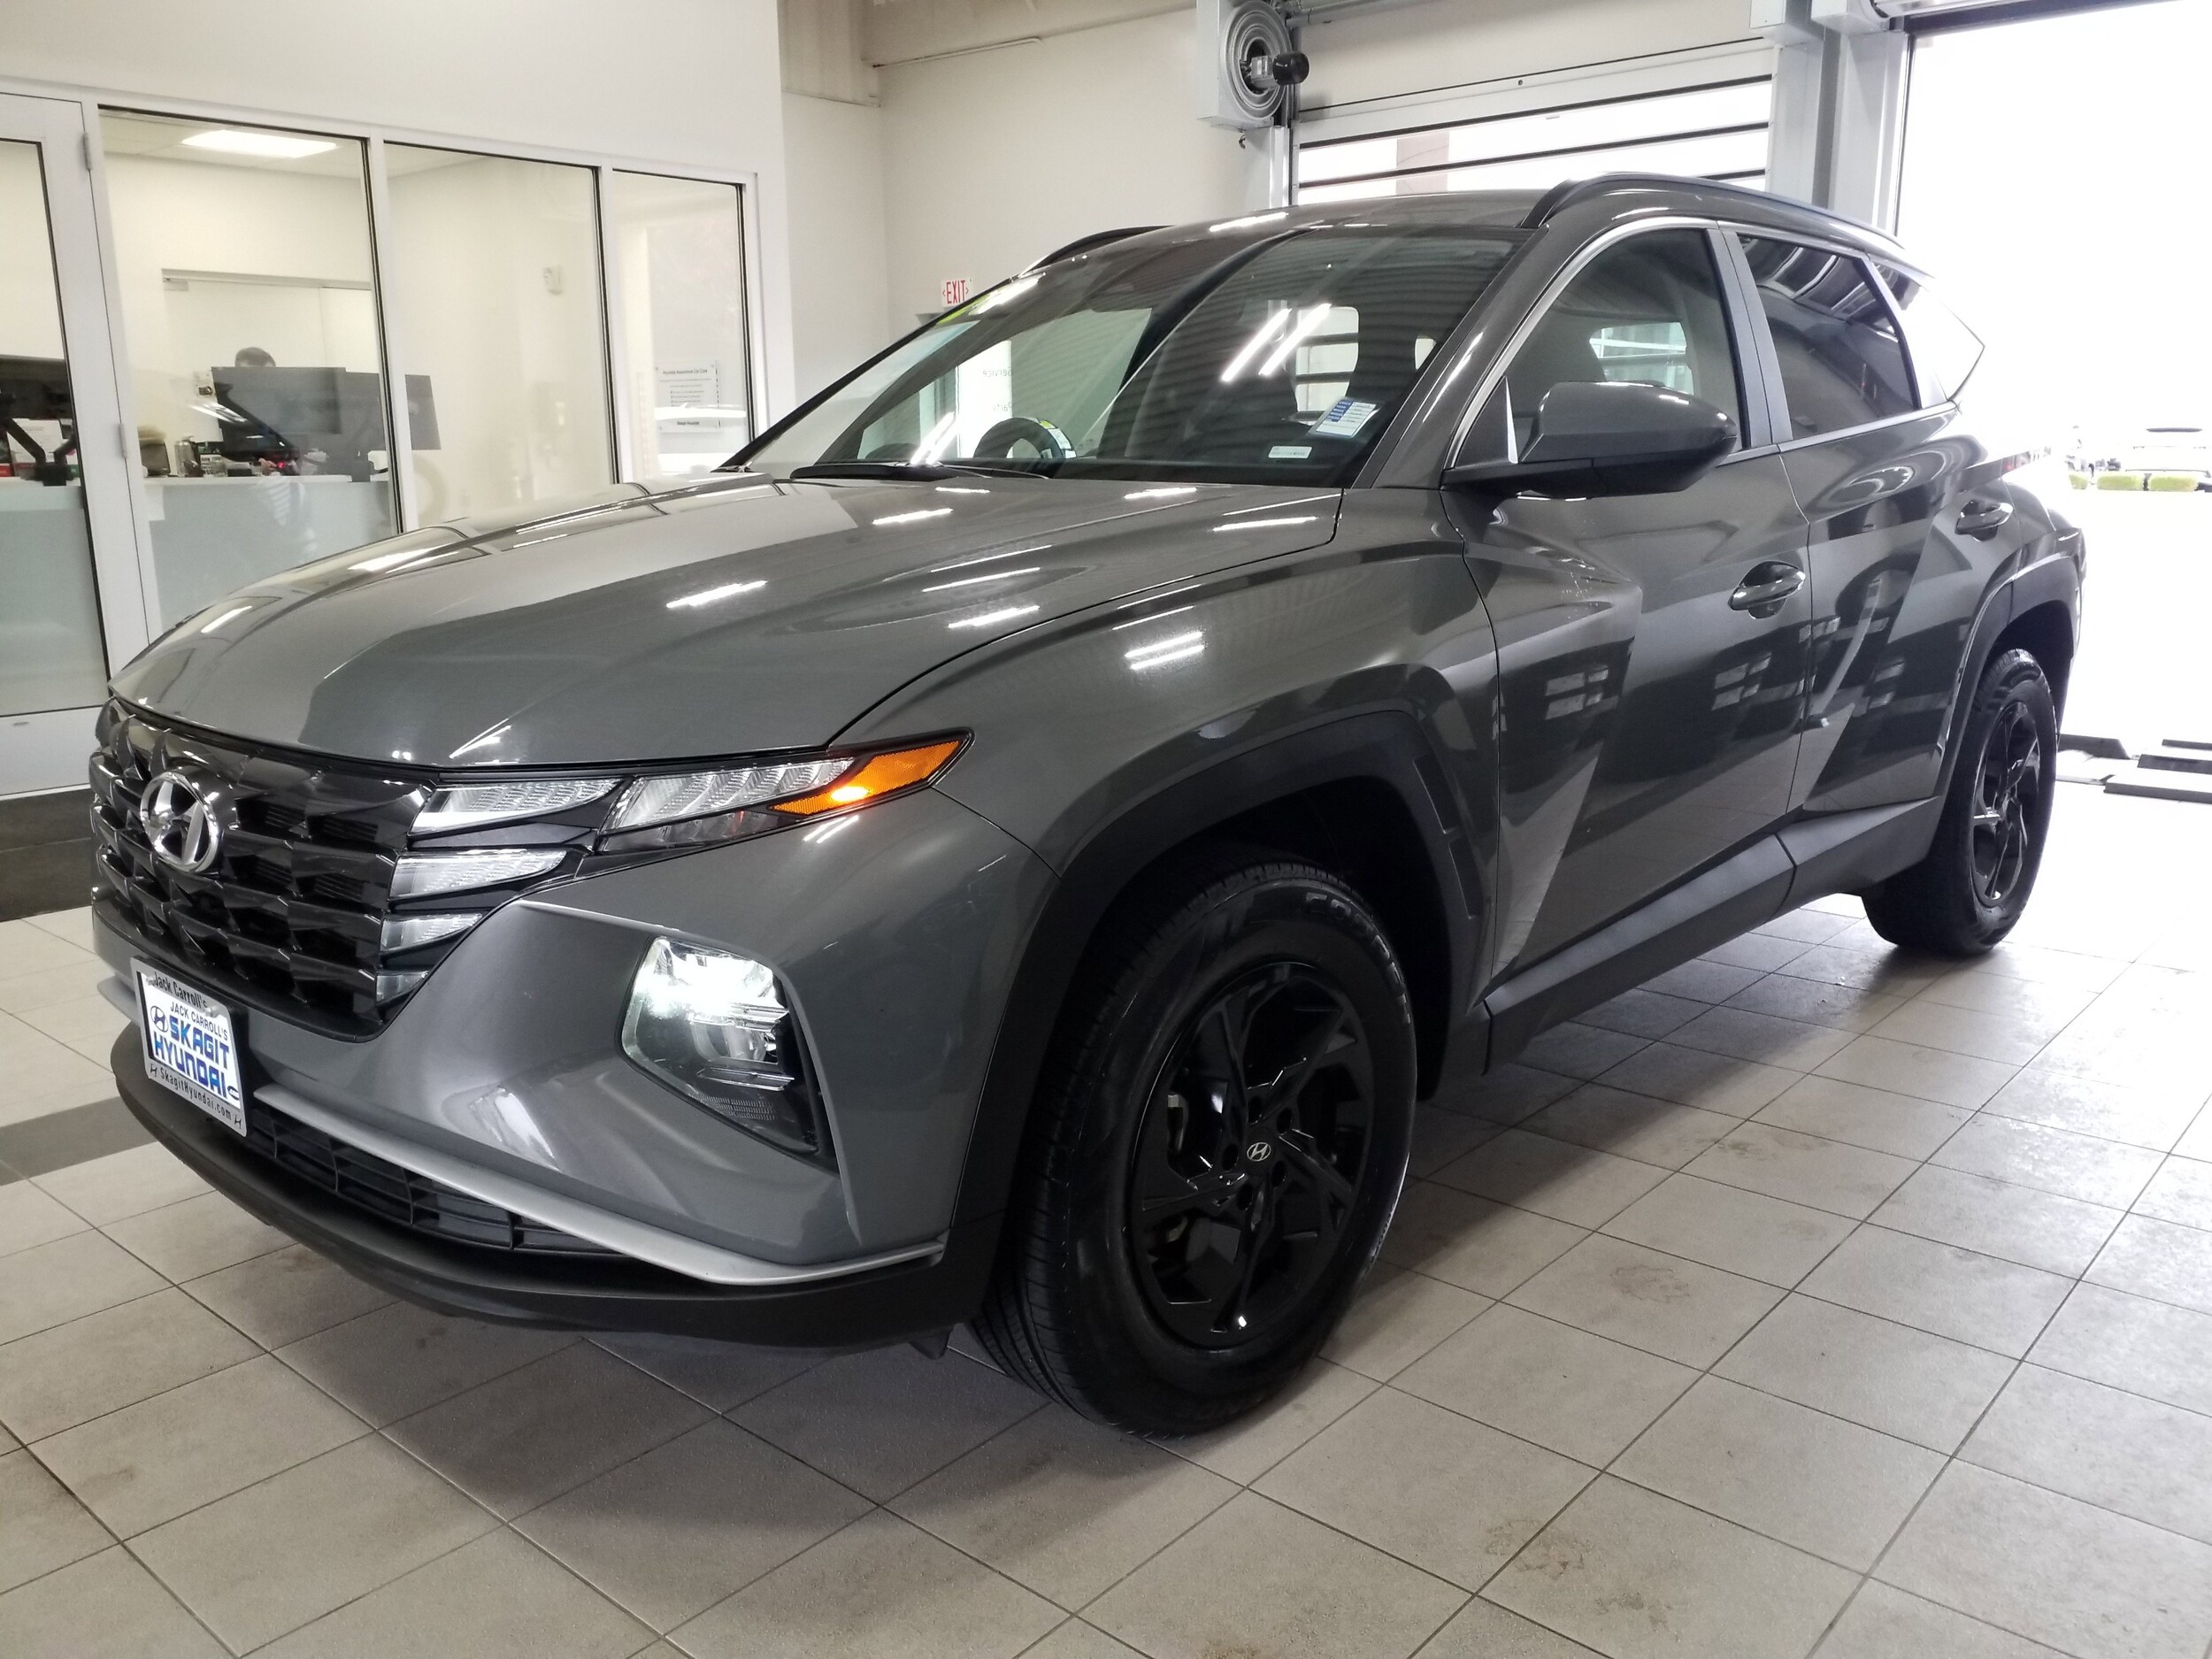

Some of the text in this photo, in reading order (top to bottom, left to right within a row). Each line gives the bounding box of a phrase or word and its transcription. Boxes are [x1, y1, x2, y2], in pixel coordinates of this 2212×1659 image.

[946, 280, 966, 303] EXIT
[155, 972, 173, 994] Jack
[169, 1014, 229, 1070] SKAGIT
[171, 1002, 228, 1041] JACK CARROLL'S
[154, 1031, 227, 1100] HYUNDAI
[160, 1067, 232, 1120] SkagitHyundai.com
